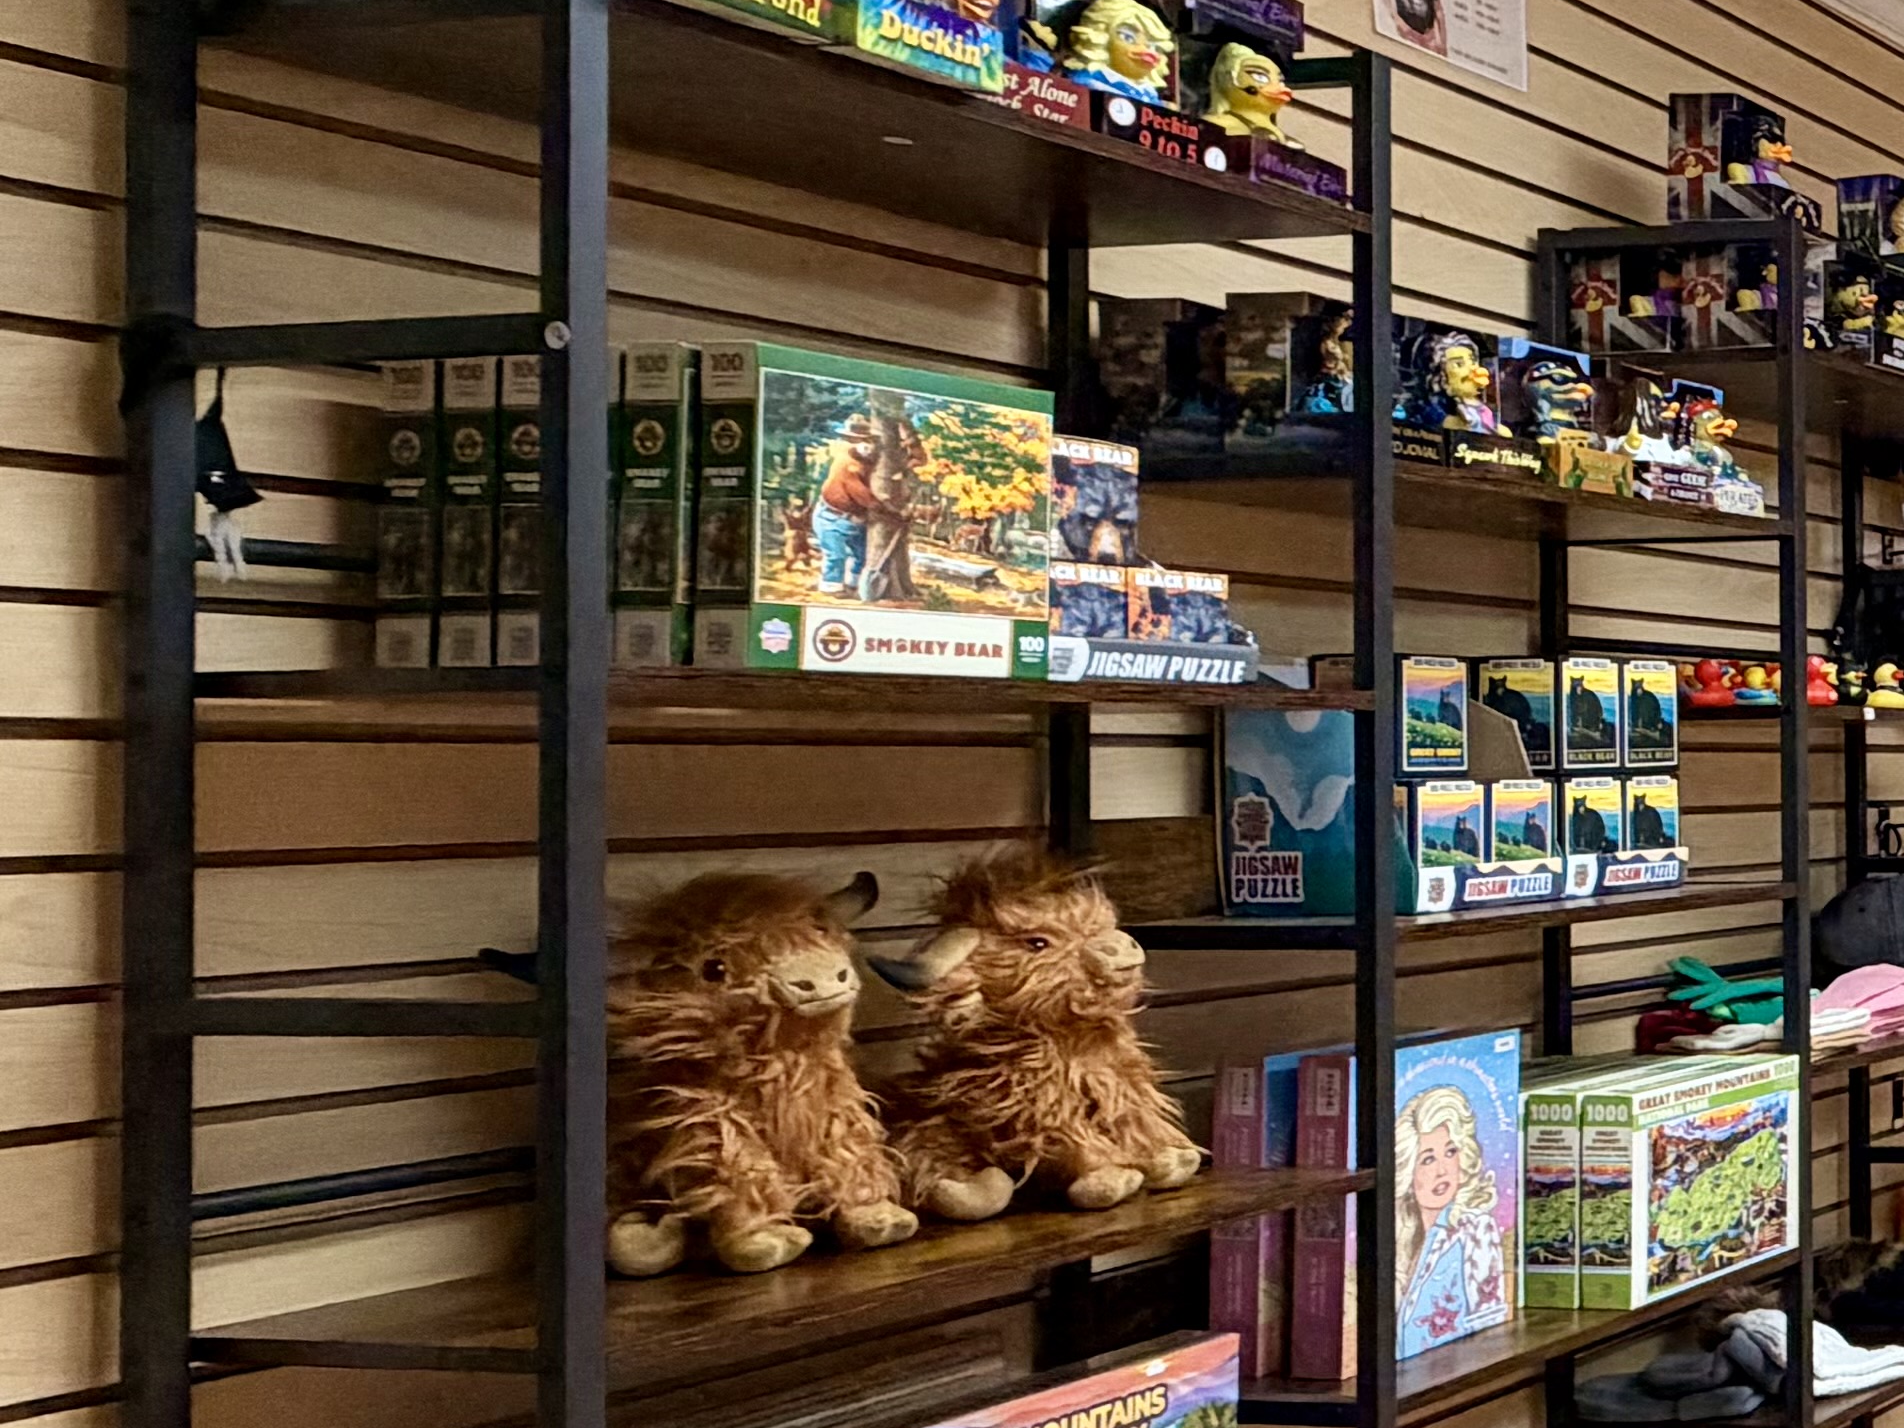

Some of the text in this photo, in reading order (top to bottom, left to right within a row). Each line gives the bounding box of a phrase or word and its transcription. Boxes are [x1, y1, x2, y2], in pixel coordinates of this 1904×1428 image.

[879, 9, 990, 68] Duckin'
[1027, 72, 1079, 108] Alone
[1052, 437, 1134, 465] LACK BEAR
[1134, 570, 1224, 593] BLACK BEAR
[863, 635, 1004, 659] SMOKEY BEAR
[1019, 635, 1044, 653] 100
[1086, 650, 1246, 684] JIGSAW PUZZLE
[1234, 855, 1299, 876] JIGSAW
[1643, 861, 1679, 880] PUZZLE
[1234, 878, 1300, 899] PUZZLE
[1510, 875, 1551, 894] PUZZLE
[1638, 1093, 1672, 1111] GREAT
[1715, 1069, 1771, 1093] MOUNTAINS
[1530, 1103, 1573, 1121] 1000
[1586, 1104, 1629, 1122] 1000
